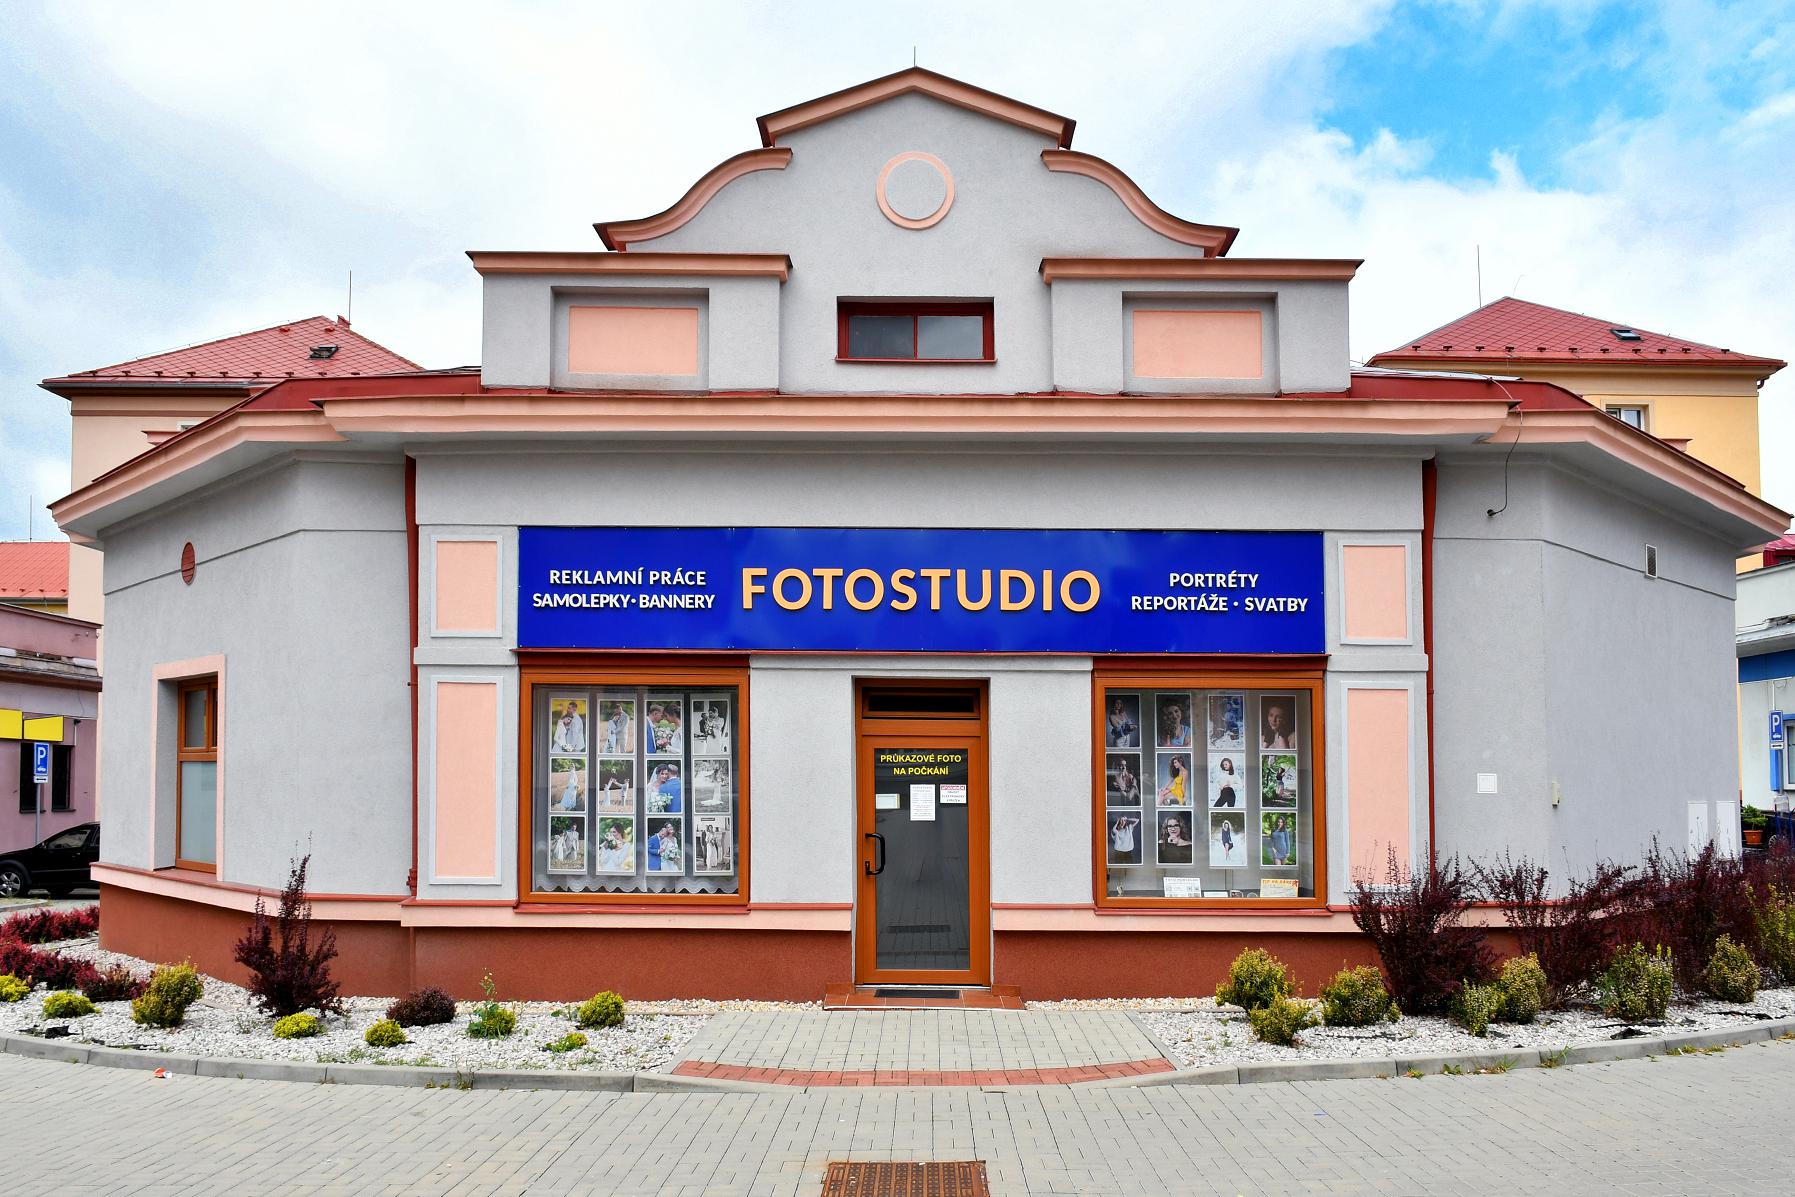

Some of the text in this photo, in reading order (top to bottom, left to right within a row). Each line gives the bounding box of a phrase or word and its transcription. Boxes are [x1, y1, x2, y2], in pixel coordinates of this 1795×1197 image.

[549, 567, 707, 586] REKLAMNÍ PRÁCE
[1169, 570, 1259, 588] PORTRÉTY
[742, 567, 1101, 612] FOTOSTUDIO
[532, 592, 716, 609] SAMOLEPKY BANNERY
[1131, 593, 1309, 612] REPORTÁŽE SVATBY
[1772, 714, 1780, 732] P
[37, 747, 46, 765] P
[880, 754, 962, 763] PRŮKAZOVÉ FOTO
[893, 766, 949, 775] NA POČKÁNÍ
